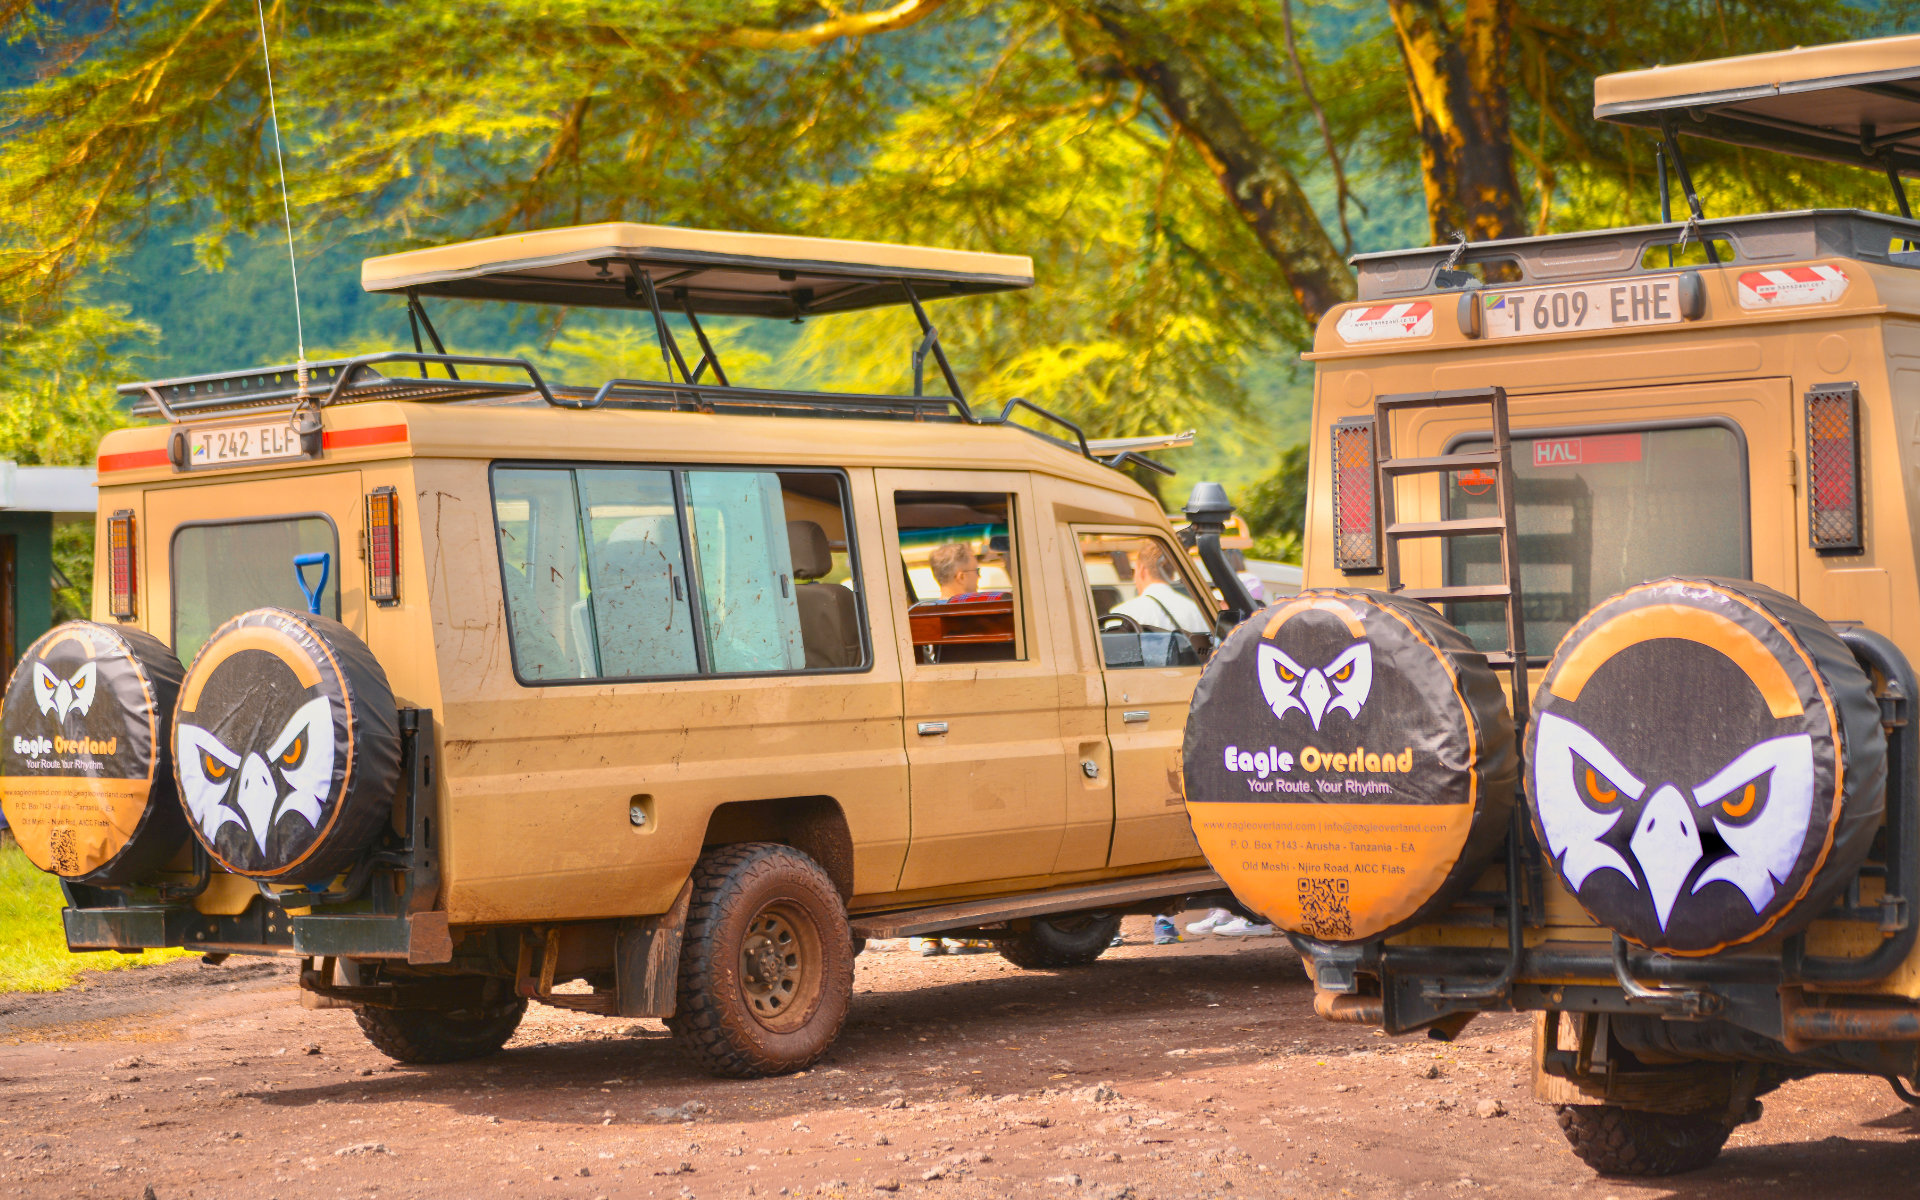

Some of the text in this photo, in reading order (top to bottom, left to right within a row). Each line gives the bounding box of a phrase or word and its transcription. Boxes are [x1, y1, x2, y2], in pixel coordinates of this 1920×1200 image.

[1507, 283, 1672, 332] T 609 EHE
[203, 426, 294, 460] T 242 ELF
[13, 735, 117, 759] Eagle Overland
[25, 759, 40, 769] Your
[75, 759, 105, 772] Rhythm.
[1223, 745, 1413, 779] Eagle Overland
[1247, 778, 1393, 796] Your Route. Your Rhythm.
[1203, 820, 1316, 832] www.eagleoverland.com
[1324, 821, 1448, 834] info@eagleoverland.com
[1230, 840, 1239, 850] P.
[1254, 840, 1272, 850] Box
[1275, 840, 1297, 851] 7143
[1306, 841, 1340, 851] Arusha
[1349, 841, 1392, 852] Tanzania
[1401, 843, 1416, 853] EA
[1242, 861, 1258, 871] Old
[1261, 861, 1290, 871] Moshi
[1298, 862, 1320, 874] Njiro
[1323, 863, 1352, 873] Road,
[1354, 863, 1379, 873] AICC
[1382, 864, 1406, 874] Flats
